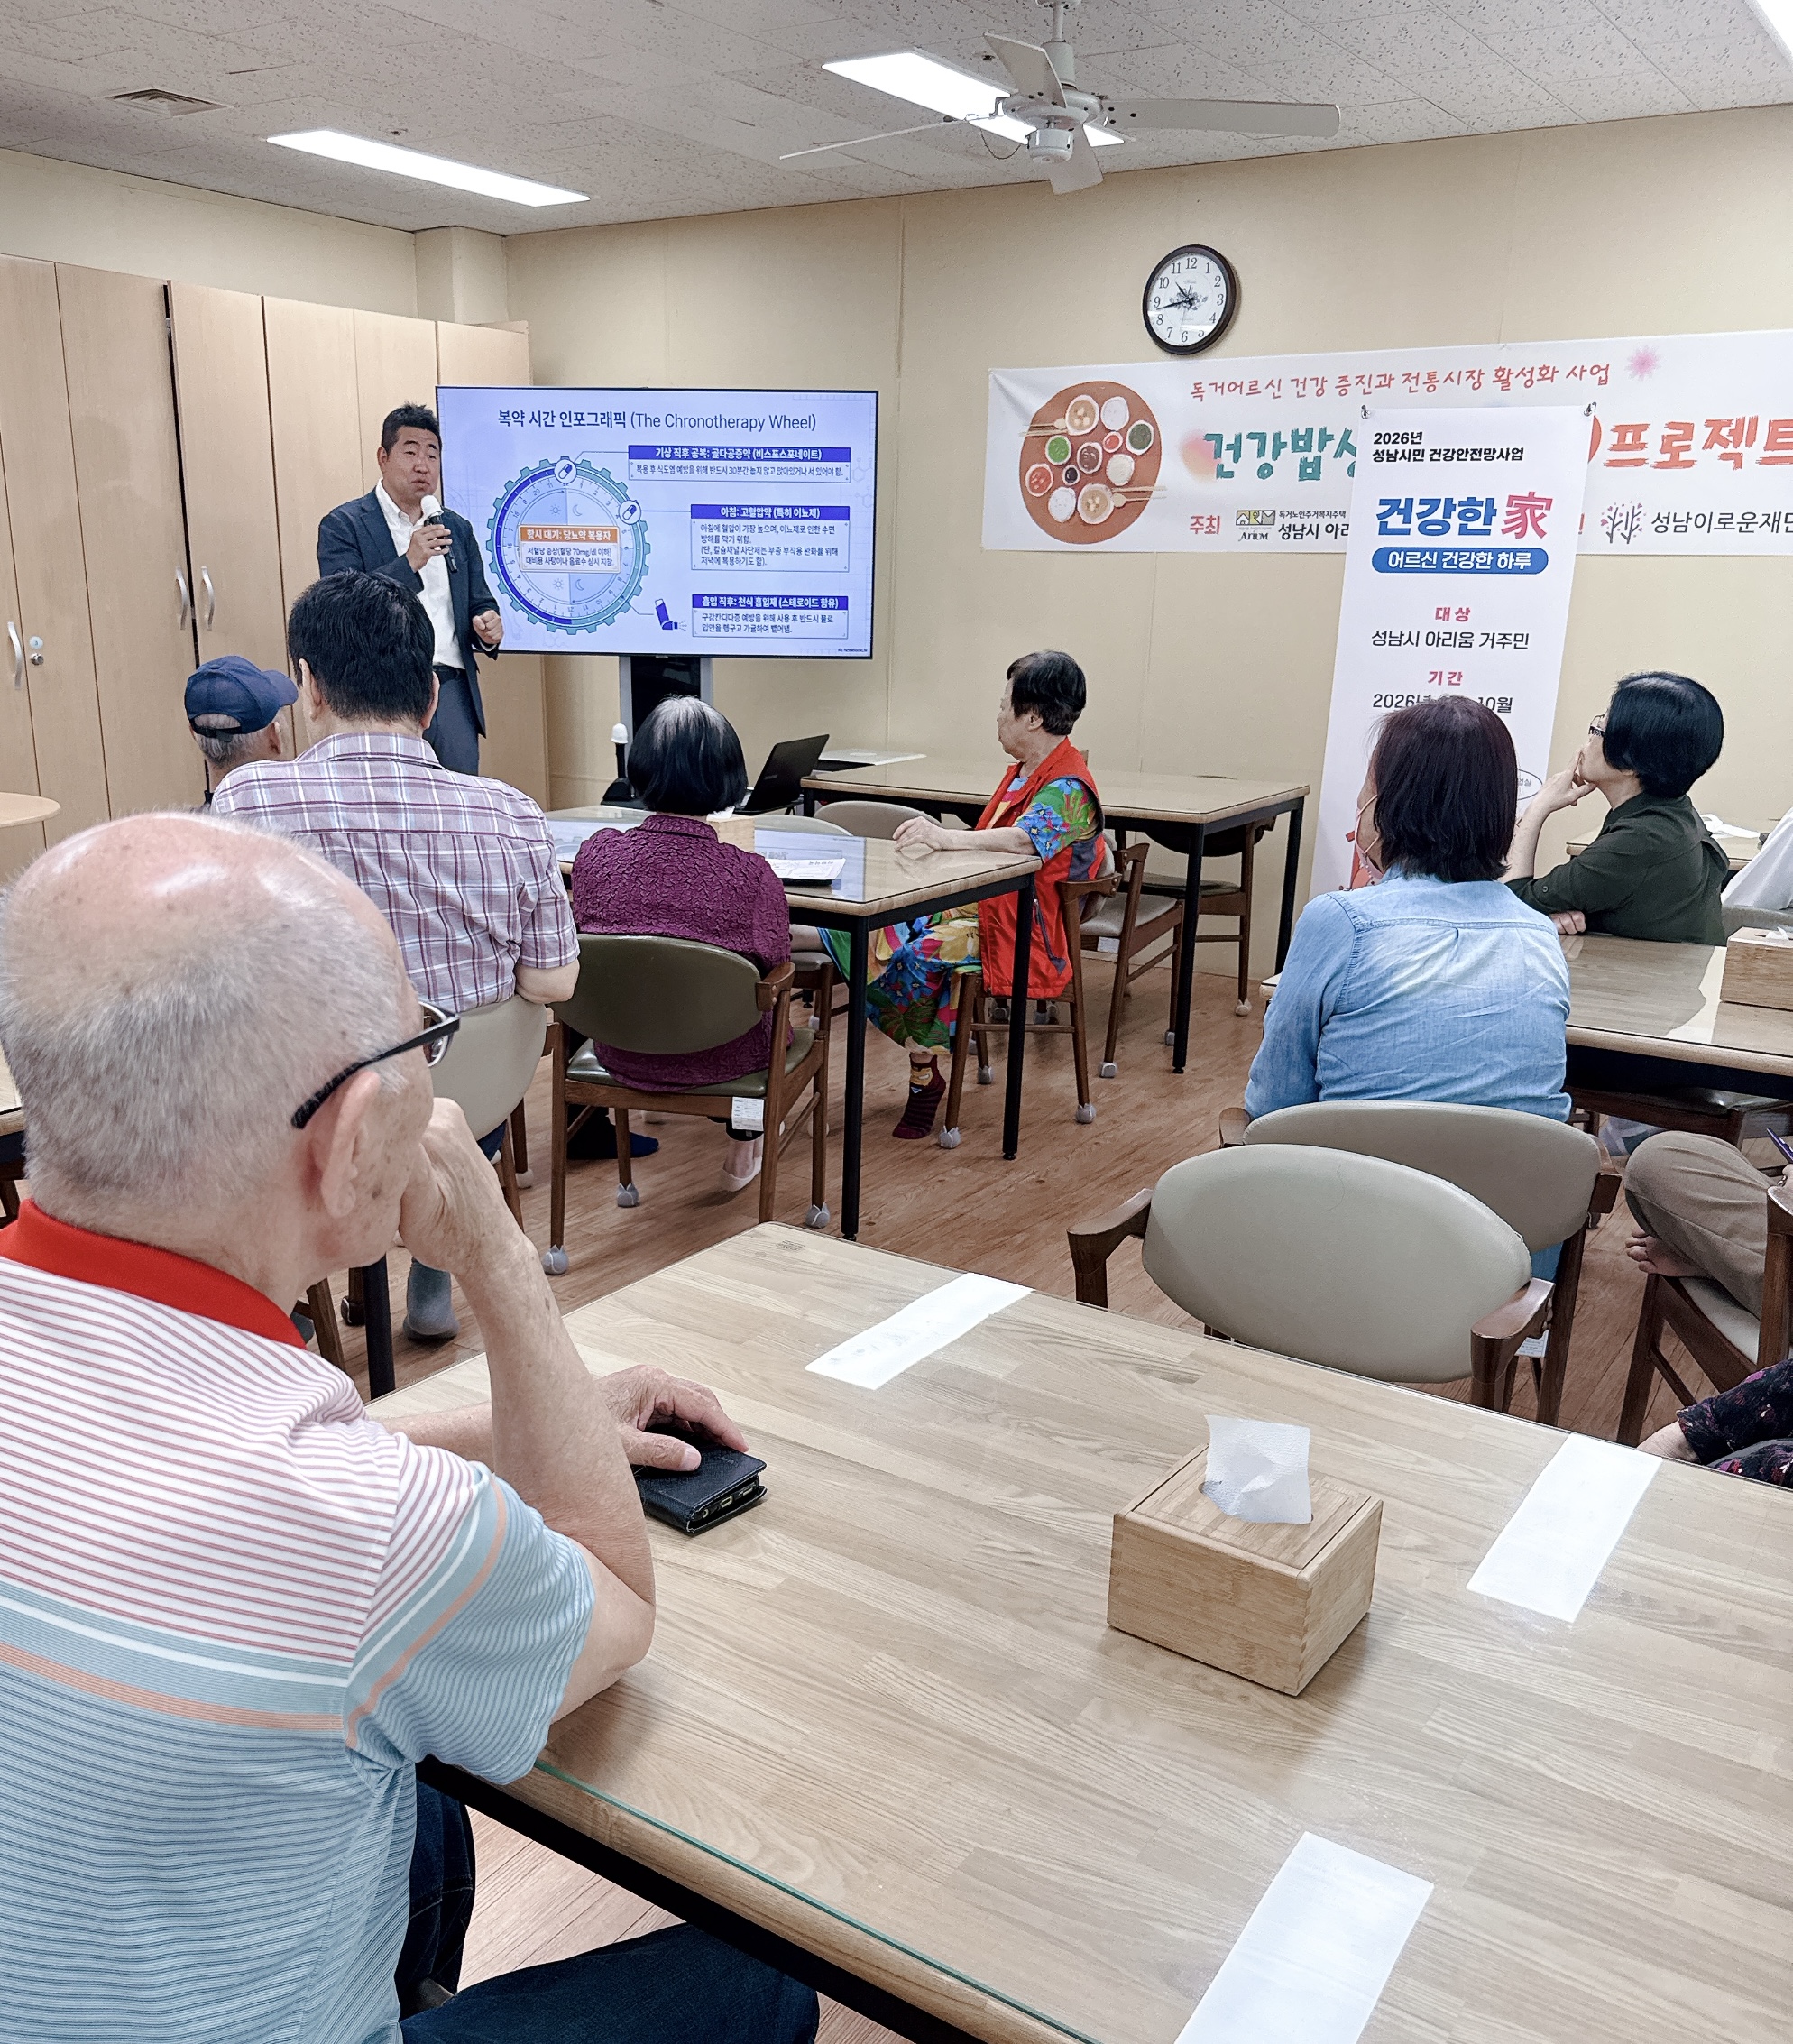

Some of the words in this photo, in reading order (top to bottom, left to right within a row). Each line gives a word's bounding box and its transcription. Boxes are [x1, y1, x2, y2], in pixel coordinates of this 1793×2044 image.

[1172, 262, 1181, 274] 11
[1186, 257, 1198, 269] 12
[1206, 262, 1210, 274] 1
[1159, 277, 1170, 289] 10
[1214, 276, 1221, 287] 2
[1154, 296, 1161, 308] 9
[1217, 293, 1224, 306] 3
[1156, 314, 1163, 325] 8
[1209, 312, 1217, 324] 4
[1166, 327, 1172, 338] 7
[1181, 331, 1188, 343] 6
[1191, 378, 1282, 402] 독거어르신
[1291, 376, 1328, 398] 건강
[1334, 373, 1394, 397] 증진과
[1402, 368, 1485, 394] 전통시장
[1492, 364, 1559, 391] 활성화
[1566, 363, 1610, 386] 사업
[498, 410, 525, 427] 복약
[529, 410, 556, 428] 시간
[559, 410, 626, 428] 인포그래픽
[630, 412, 661, 428] (The
[665, 413, 765, 432] Chronotherapy
[769, 413, 816, 431] Wheel)
[1373, 431, 1423, 445] 2026년
[1603, 415, 1793, 471] 프로젝트
[656, 447, 672, 458] 기상
[674, 447, 690, 458] 직후
[1372, 448, 1425, 462] 성남시민
[1429, 447, 1524, 462] 건강안전망사업
[721, 507, 739, 517] 아침:
[1278, 511, 1347, 520] 독거노인주거복지주택
[1375, 496, 1498, 537] 건강한
[1501, 492, 1553, 539] 家
[1189, 514, 1220, 535] 주최
[527, 529, 542, 540] 항시
[543, 529, 562, 540] 대기:
[563, 529, 586, 541] 당뇨약
[1278, 523, 1319, 540] 성남시
[1388, 551, 1437, 569] 어르신
[1441, 551, 1494, 569] 건강한
[1497, 552, 1531, 570] 하루
[1372, 631, 1419, 648] 성남시
[1425, 631, 1475, 649] 아리움
[1478, 632, 1530, 649] 거주민
